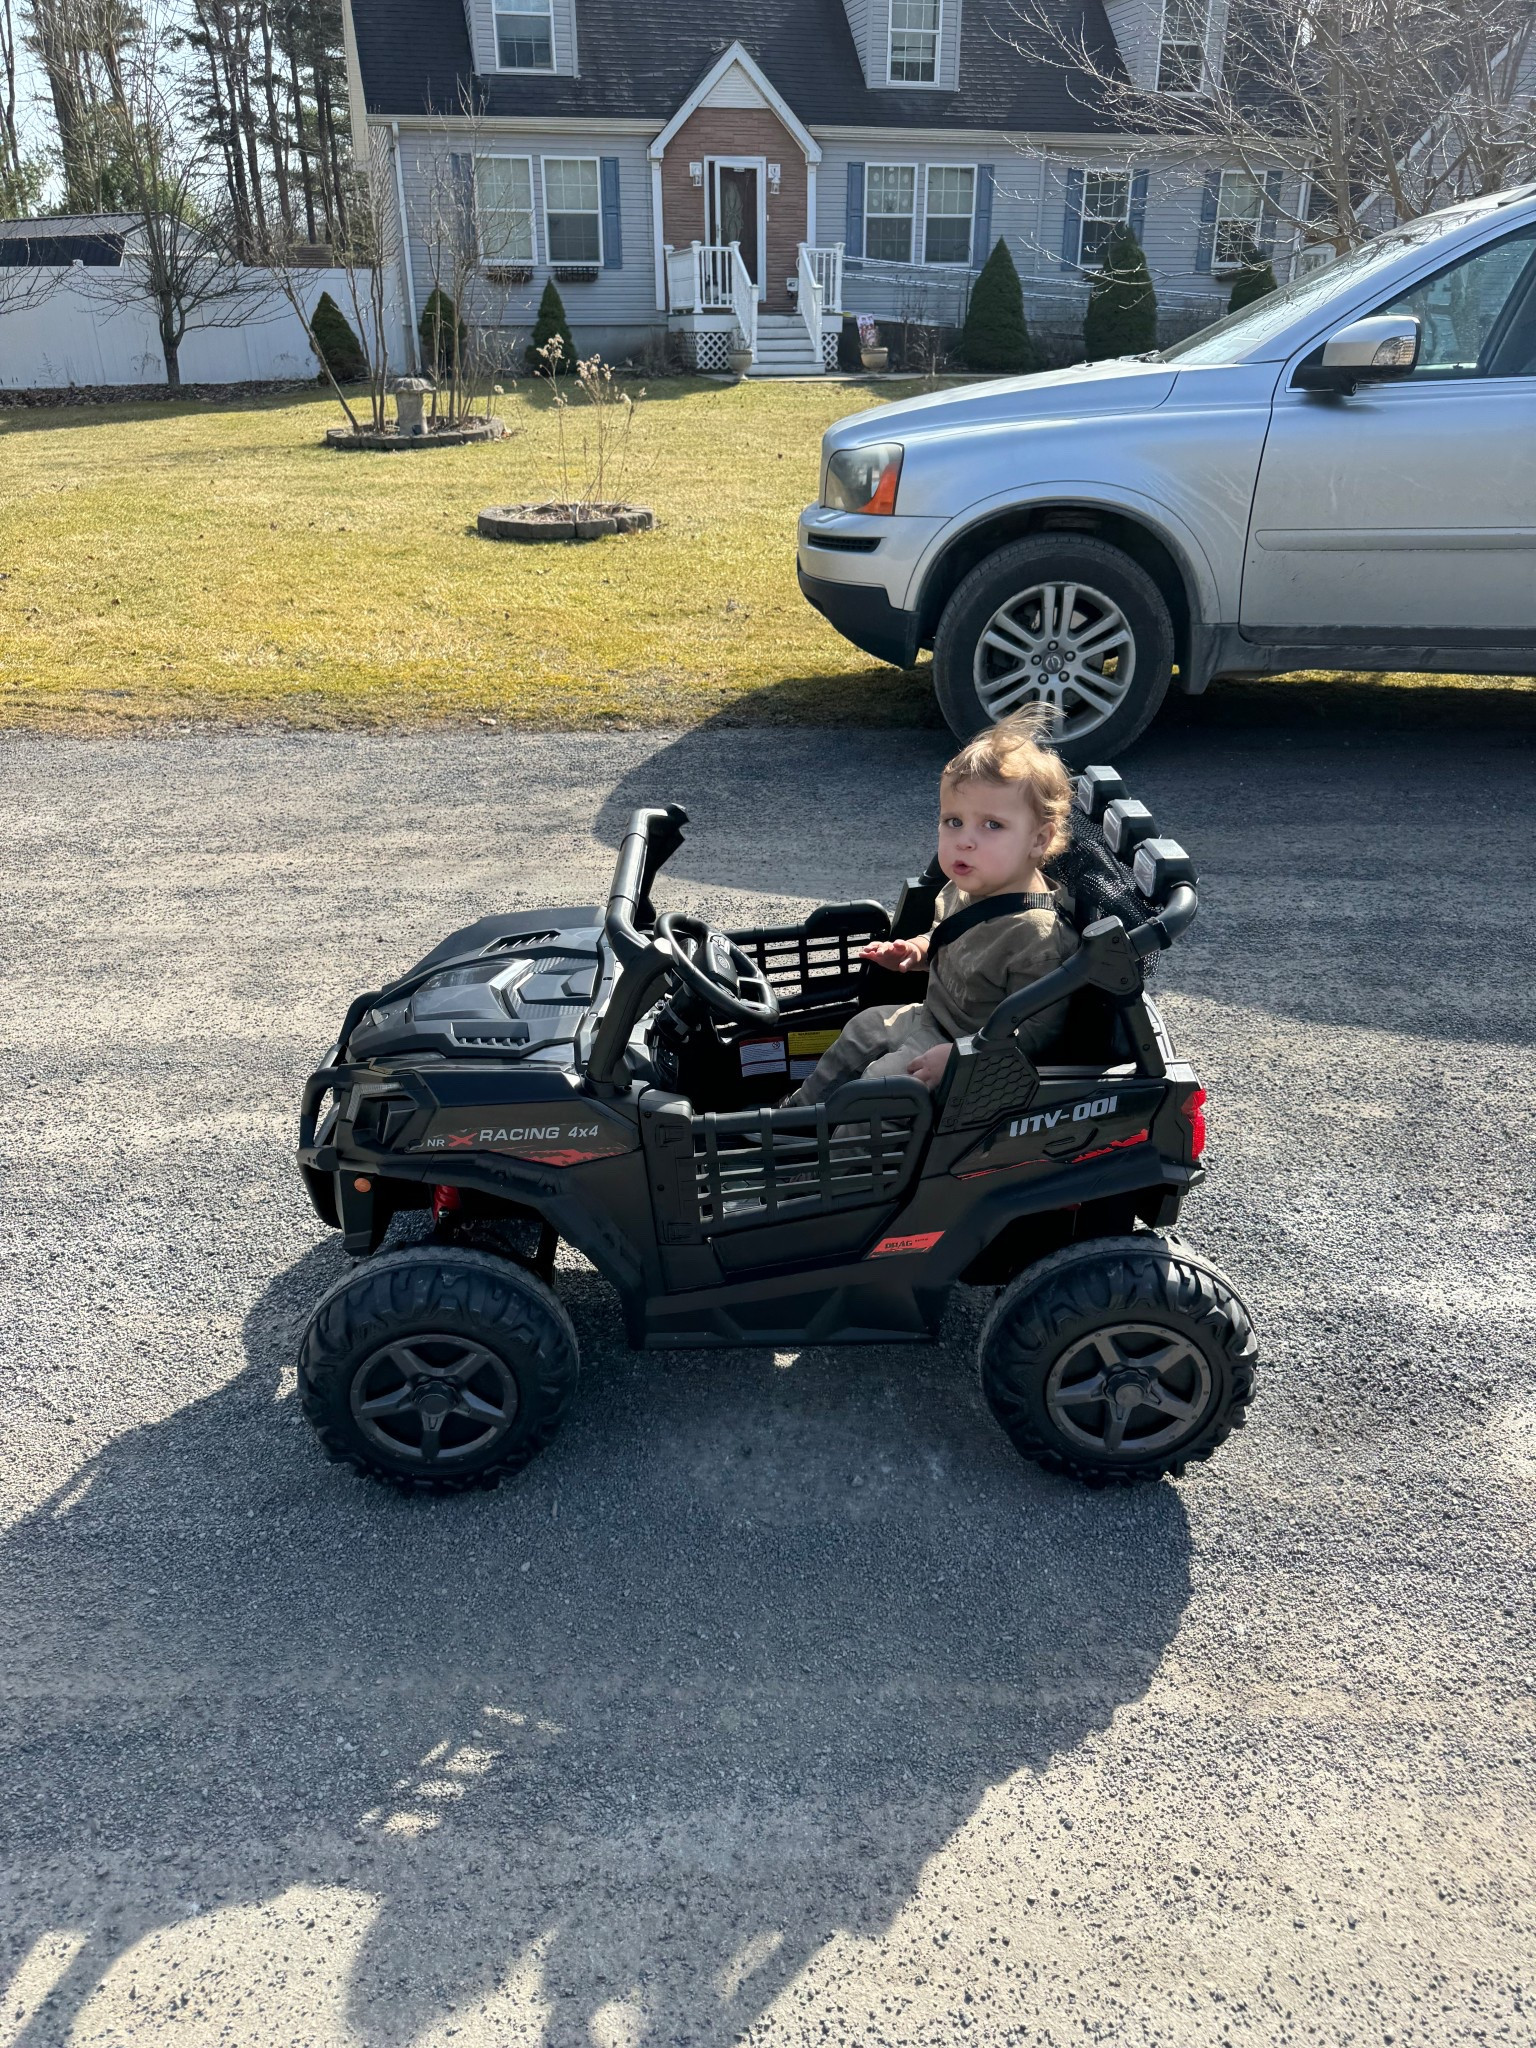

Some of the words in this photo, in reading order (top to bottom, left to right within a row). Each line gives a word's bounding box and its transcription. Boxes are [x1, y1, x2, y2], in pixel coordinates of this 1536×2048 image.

[1009, 1096, 1117, 1137] UTV-001
[427, 1138, 445, 1147] NR
[479, 1126, 560, 1142] RACING
[567, 1125, 599, 1138] 4x4
